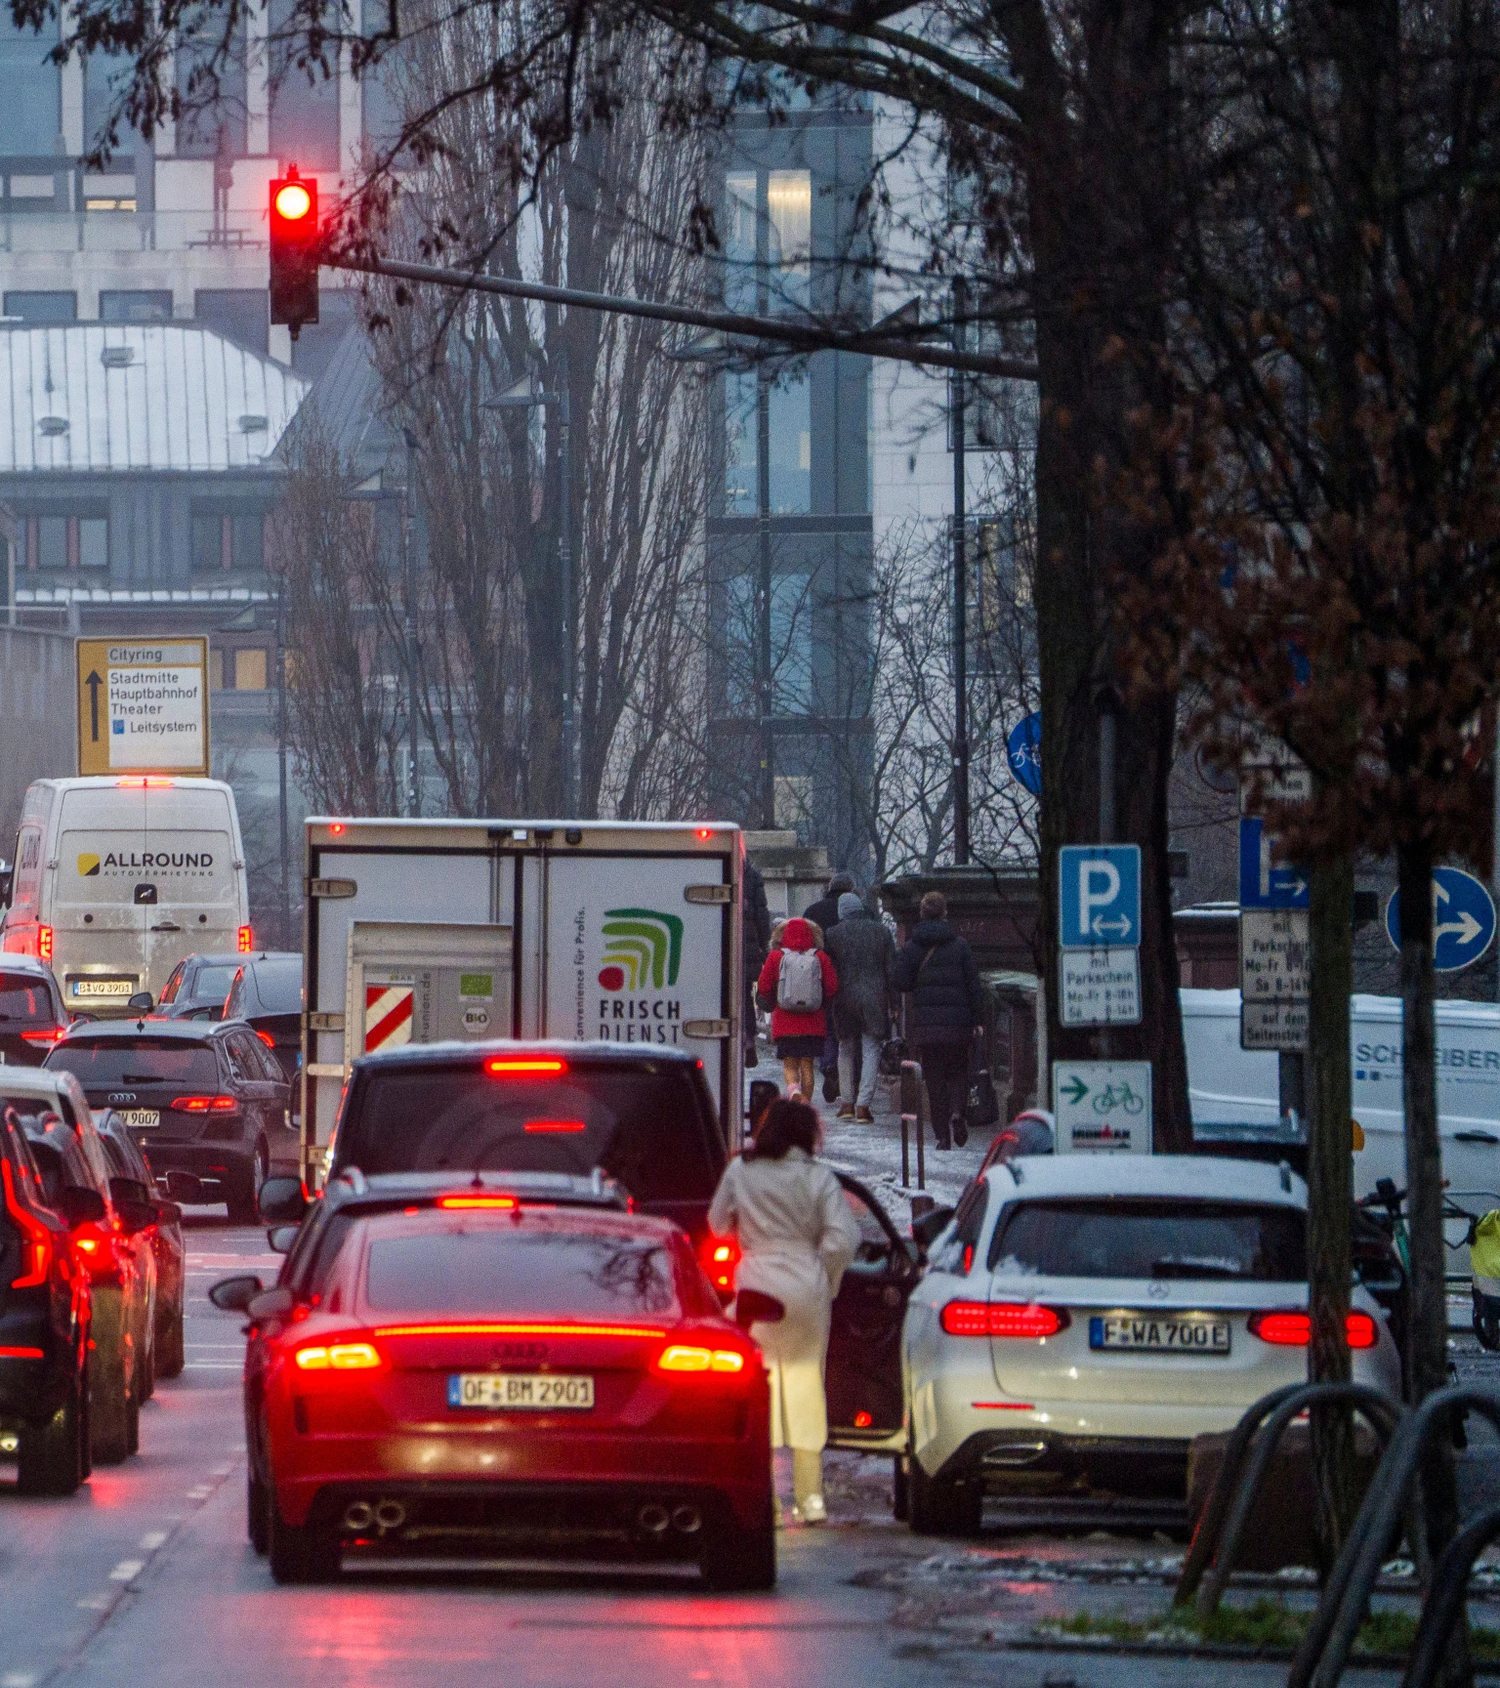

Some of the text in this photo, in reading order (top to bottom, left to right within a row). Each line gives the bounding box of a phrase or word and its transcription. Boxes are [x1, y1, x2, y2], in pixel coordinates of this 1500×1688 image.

[109, 648, 162, 663] Cityring
[110, 671, 179, 685] Stadtmitte
[110, 686, 198, 702] Hauptbahnhof
[111, 703, 163, 715] Theater
[130, 721, 197, 735] Leitsystem
[103, 853, 213, 868] ALLROUND
[1079, 860, 1120, 934] P
[574, 906, 586, 944] Profis.
[574, 949, 585, 965] für
[1066, 972, 1133, 985] Parkschein
[600, 1000, 680, 1020] FRISCH
[600, 1024, 679, 1043] DIENST
[131, 1111, 159, 1125] 9007
[1104, 1321, 1117, 1340] F
[1132, 1322, 1160, 1344] WA
[465, 1380, 590, 1402] OF BM 2901
